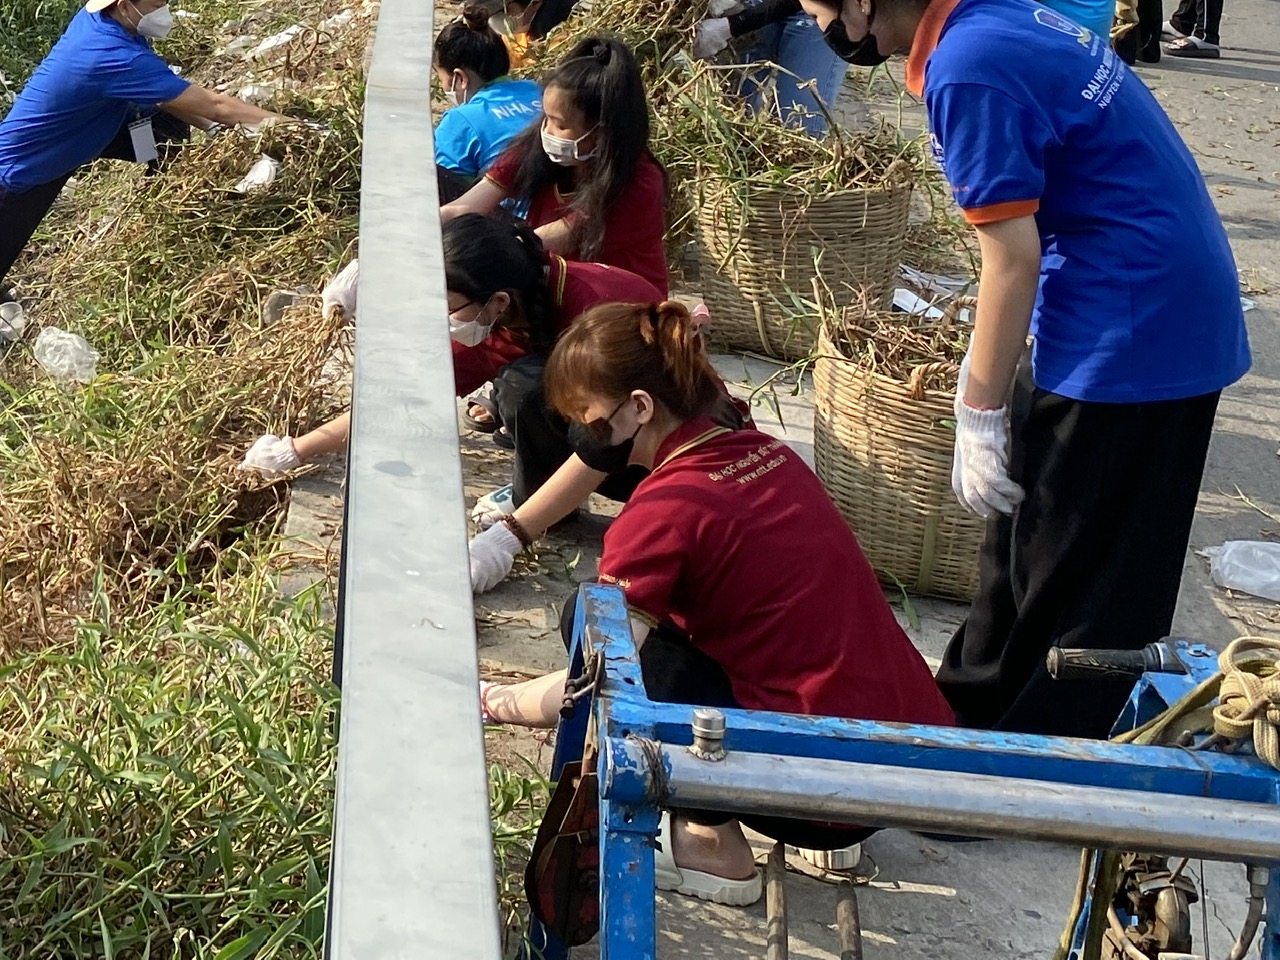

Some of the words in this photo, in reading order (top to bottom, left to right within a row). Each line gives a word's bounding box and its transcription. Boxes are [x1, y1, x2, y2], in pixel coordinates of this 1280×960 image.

[1094, 64, 1109, 84] HỌC
[491, 100, 534, 120] NHÀ
[720, 464, 737, 477] HỌC
